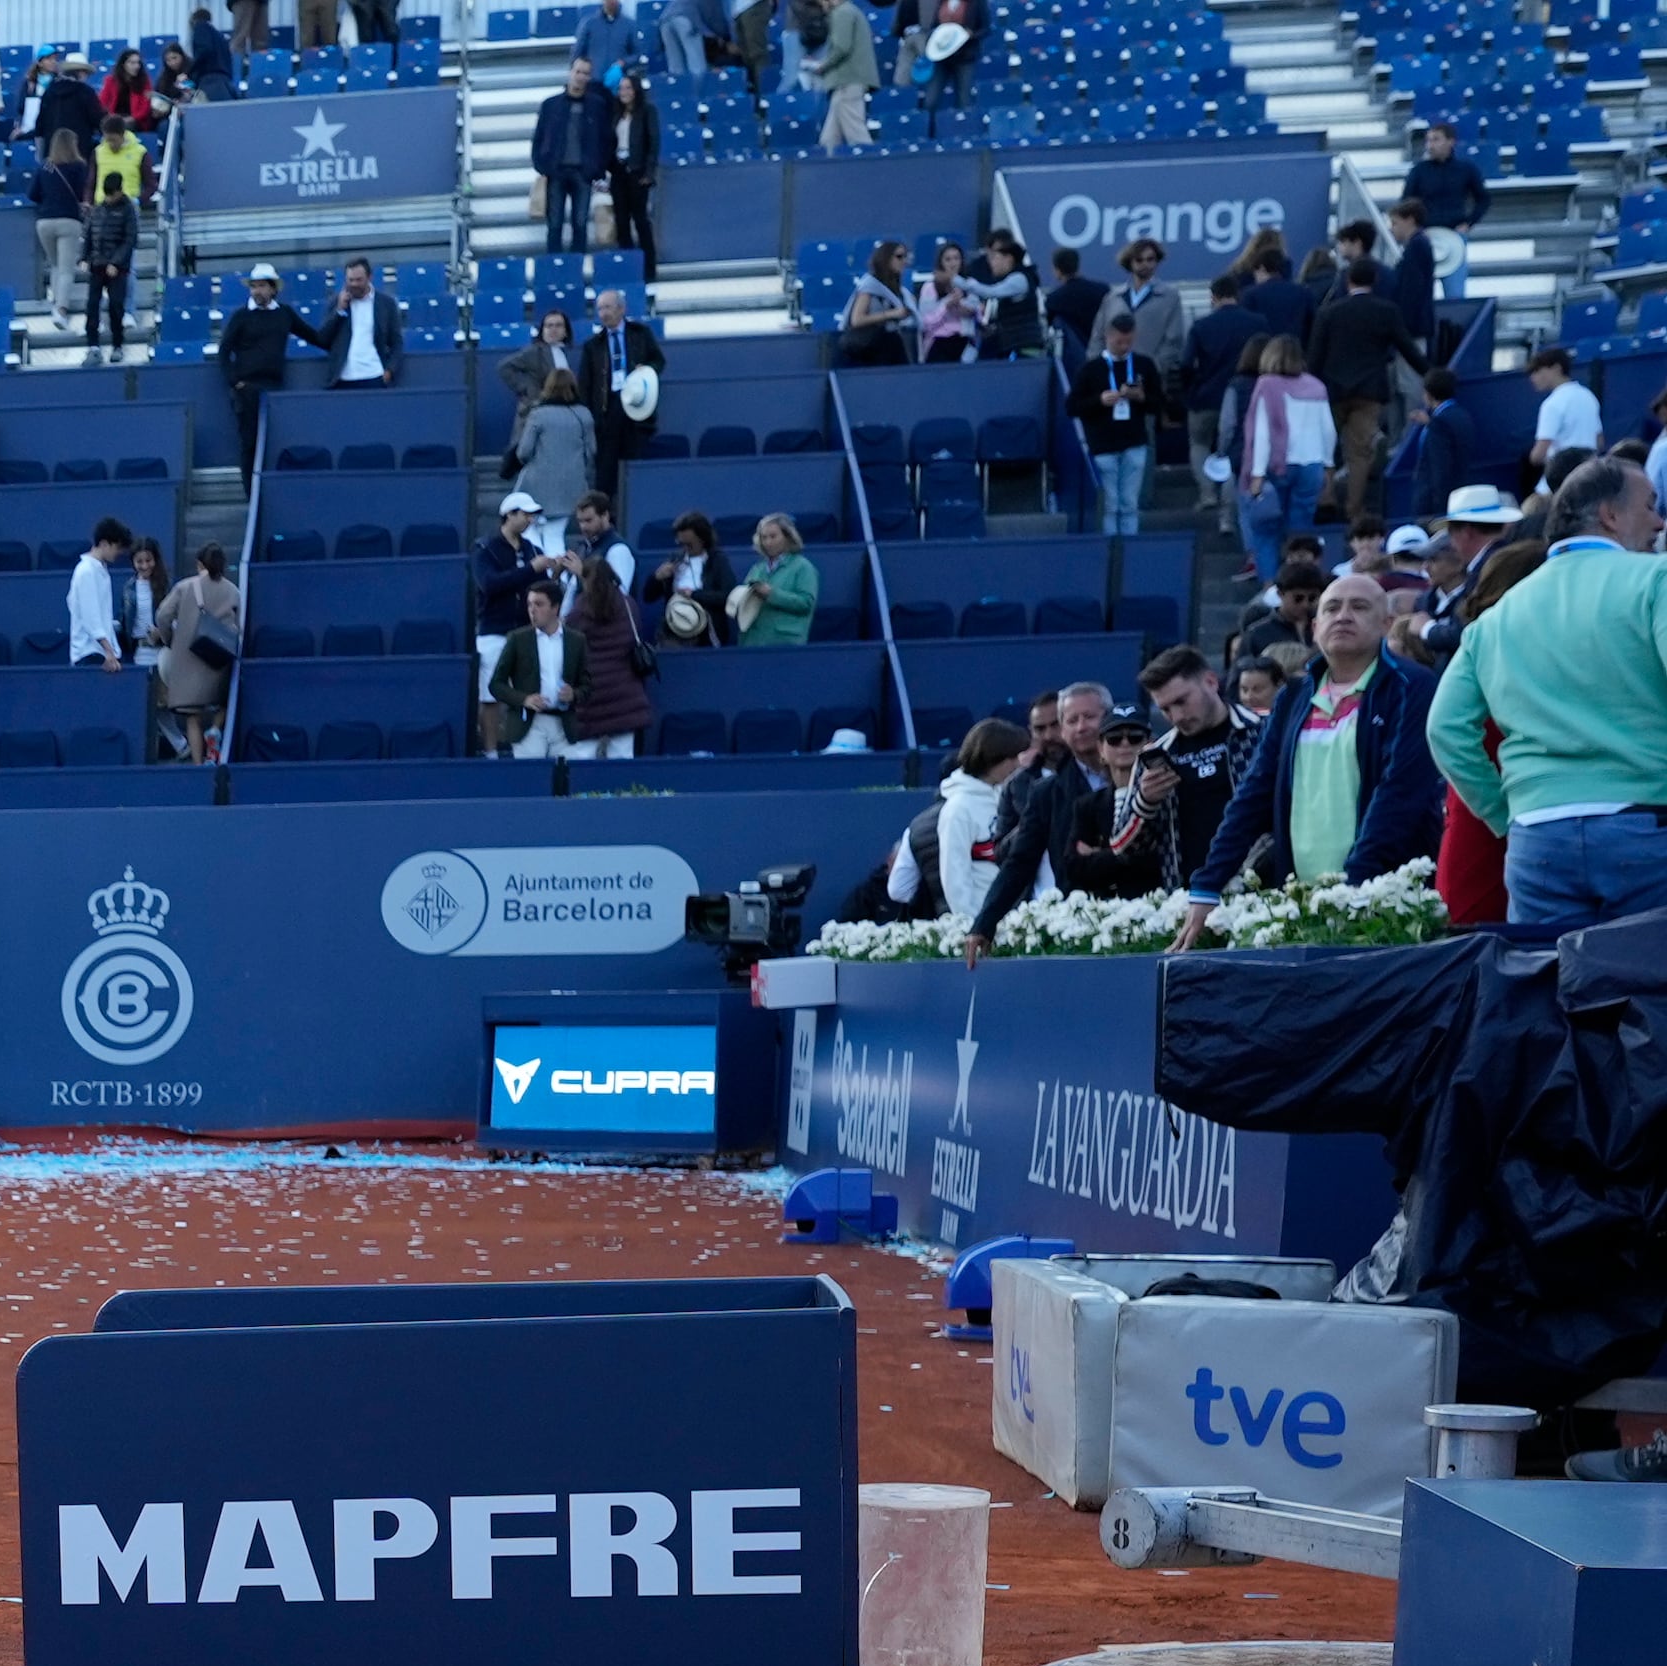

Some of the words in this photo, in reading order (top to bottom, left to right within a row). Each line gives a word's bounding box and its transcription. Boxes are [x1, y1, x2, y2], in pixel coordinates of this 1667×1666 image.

[259, 156, 379, 186] ESTRELLA
[1049, 194, 1285, 253] Orange
[503, 897, 652, 922] Barcelona
[504, 874, 624, 895] Ajuntament
[629, 872, 653, 890] de
[551, 1070, 715, 1095] CUPRA
[837, 1040, 913, 1178] Sabadell
[931, 1136, 980, 1213] ESTRELLA
[1028, 1077, 1060, 1189] LA
[1063, 1081, 1236, 1239] VANGUARDIA
[1186, 1367, 1346, 1469] tve
[58, 1488, 802, 1606] MAPFRE
[1113, 1518, 1129, 1549] 8
